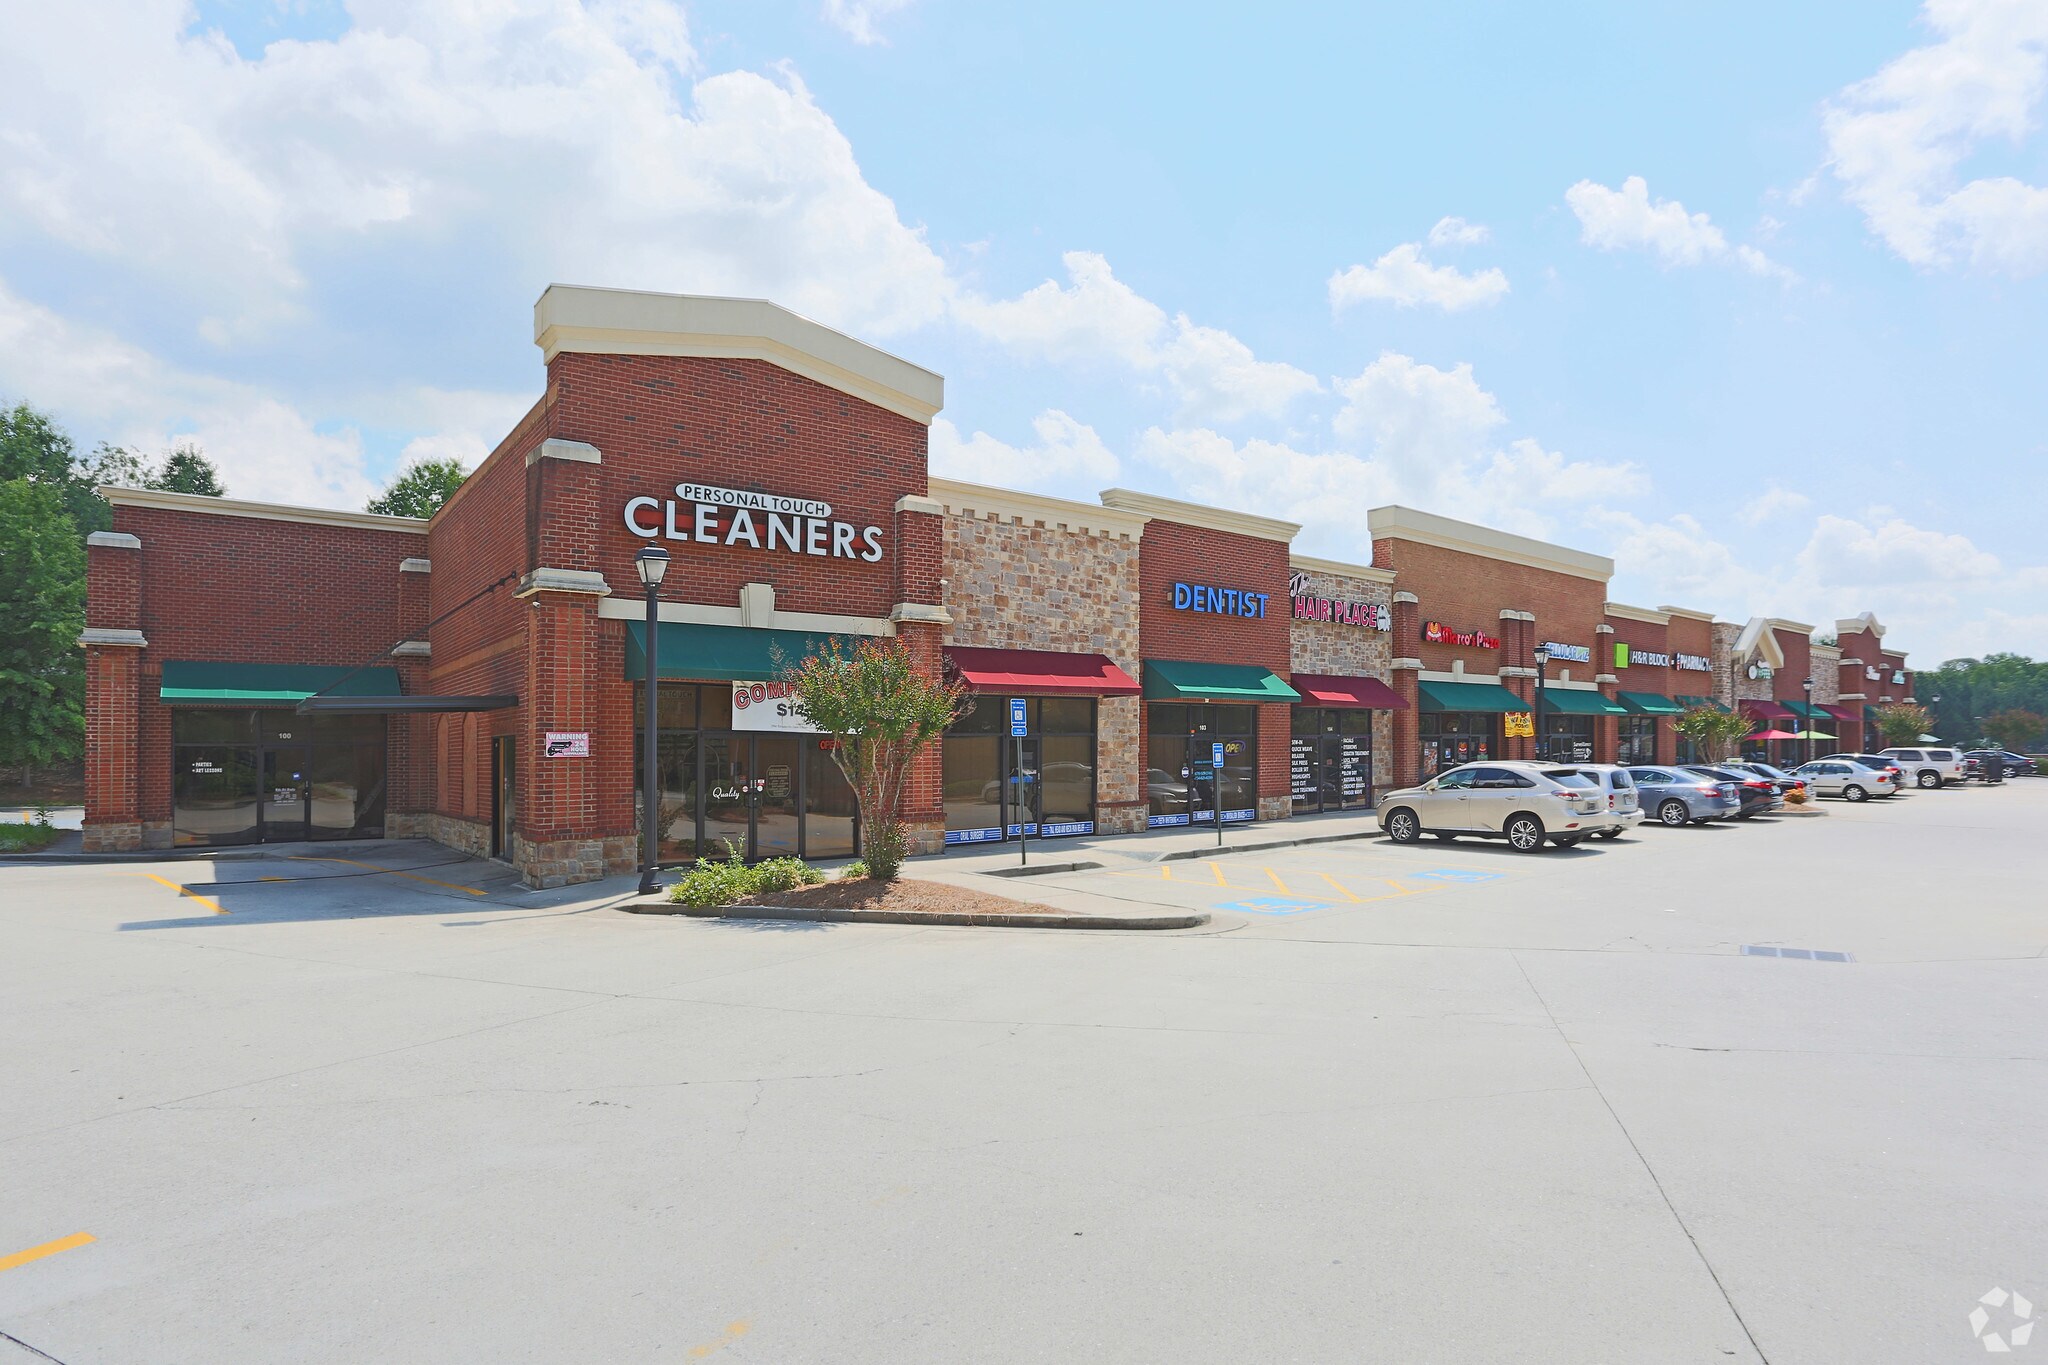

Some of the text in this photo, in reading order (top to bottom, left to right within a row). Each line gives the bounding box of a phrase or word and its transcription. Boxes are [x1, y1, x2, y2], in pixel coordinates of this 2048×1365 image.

[684, 485, 825, 516] PERSONAL TOUCH
[623, 496, 883, 563] CLEANERS
[1174, 582, 1269, 619] DENTIST
[1294, 596, 1378, 628] HAIR PLACE
[1442, 626, 1500, 649] Marco's Pizza
[1631, 651, 1670, 667] H&R BLOCK
[1680, 655, 1710, 672] PHARMACY
[712, 786, 740, 800] Quality
[959, 830, 985, 841] ORAL SURGERY
